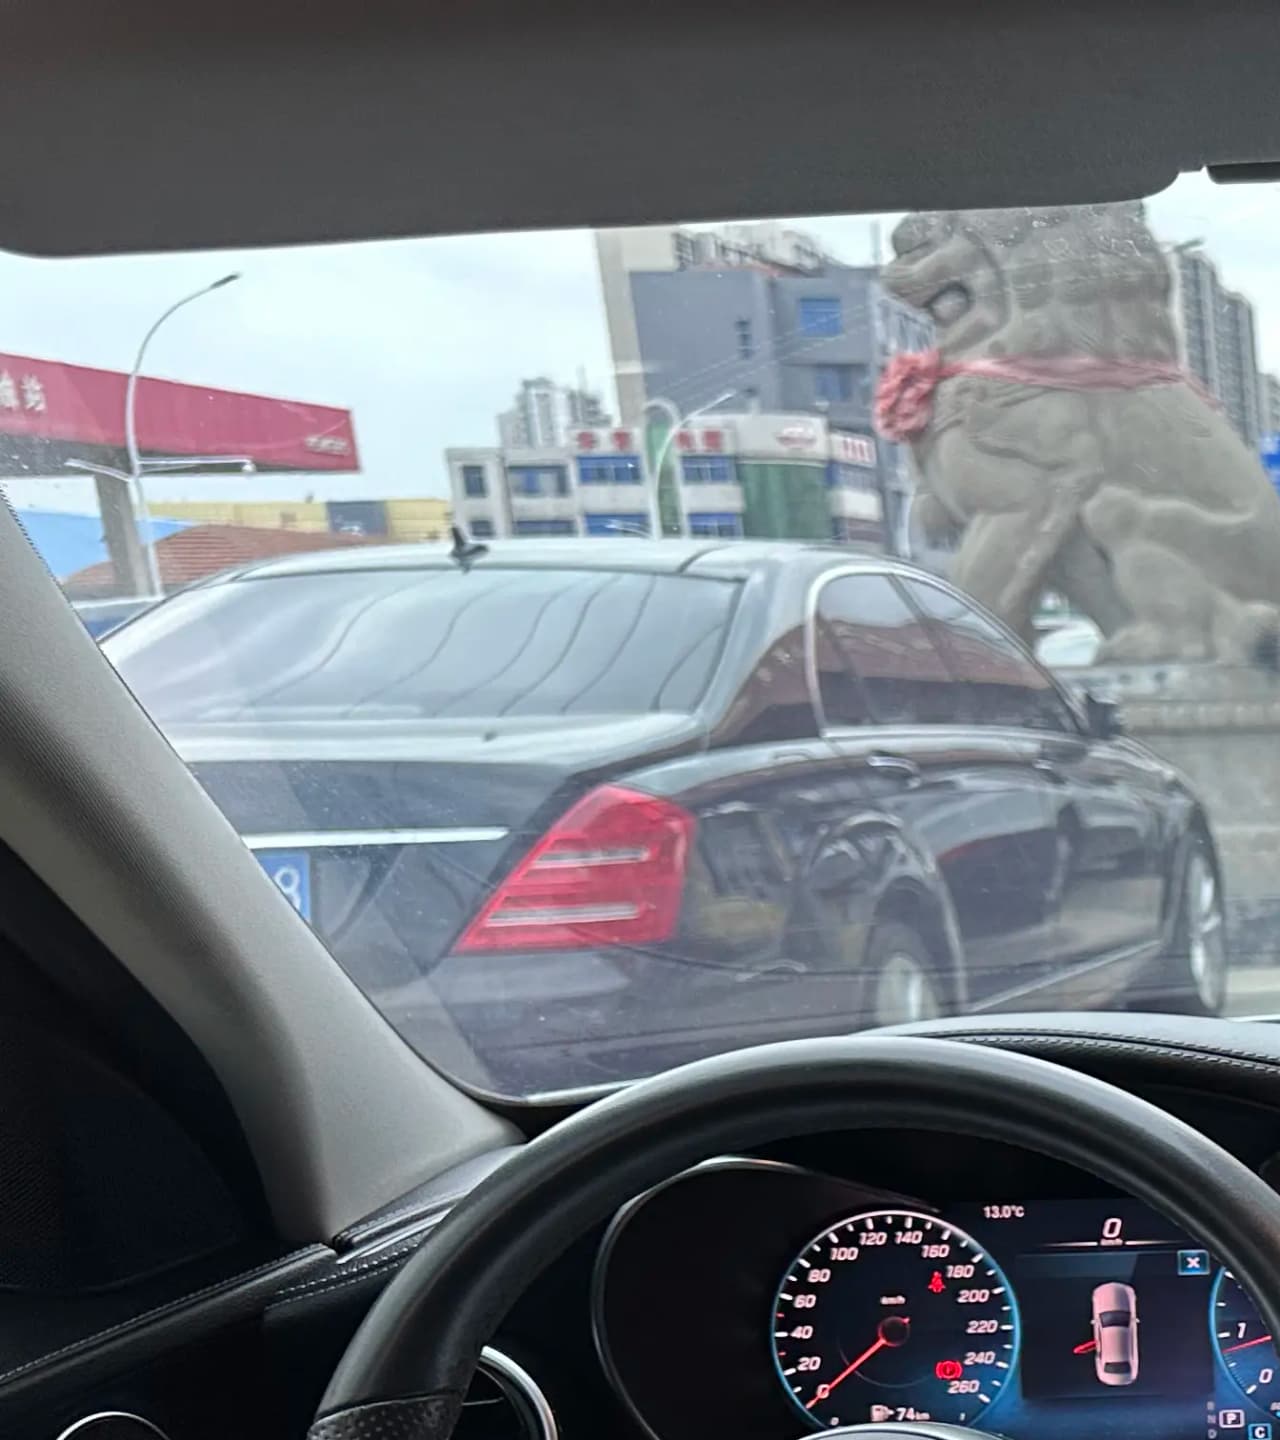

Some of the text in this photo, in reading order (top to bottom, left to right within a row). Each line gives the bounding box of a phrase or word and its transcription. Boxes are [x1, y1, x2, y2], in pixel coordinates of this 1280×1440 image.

[1102, 1218, 1122, 1238] 0
[860, 1230, 886, 1246] 120
[894, 1229, 923, 1246] 140
[830, 1246, 858, 1262] 100
[921, 1245, 949, 1259] 160
[807, 1268, 831, 1283] 80
[946, 1265, 975, 1279] 180
[794, 1293, 816, 1309] 60
[957, 1289, 989, 1304] 200
[791, 1325, 813, 1339] 40
[966, 1320, 998, 1334] 220
[1236, 1323, 1246, 1338] 1
[798, 1355, 821, 1371] 20
[963, 1351, 996, 1365] 240
[1258, 1368, 1273, 1384] 0
[948, 1380, 980, 1394] 260
[1226, 1413, 1237, 1425] P
[1208, 1429, 1217, 1439] D
[1254, 1427, 1266, 1439] C
